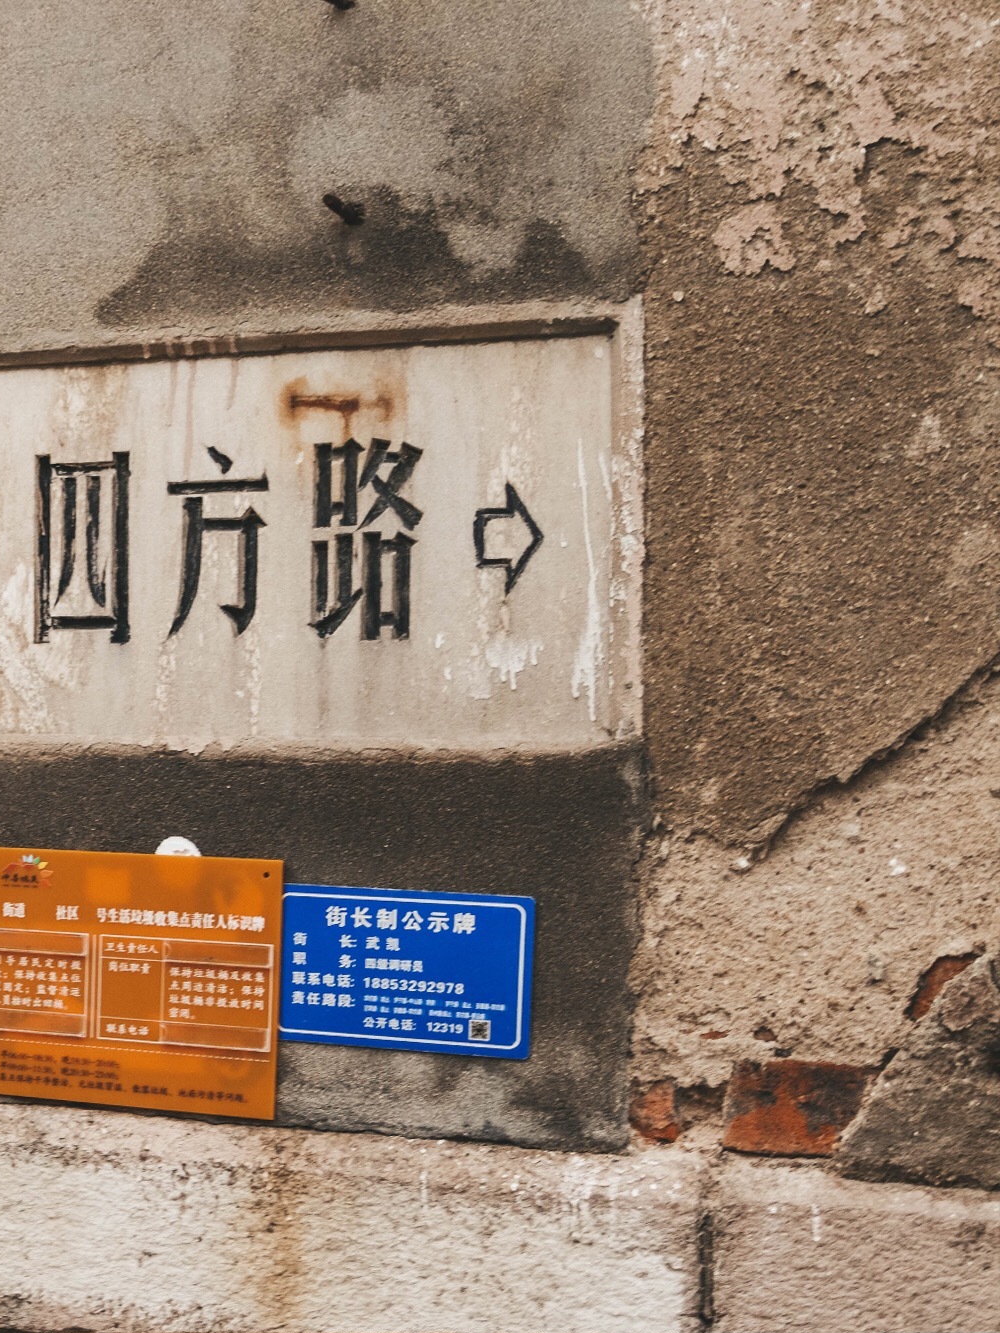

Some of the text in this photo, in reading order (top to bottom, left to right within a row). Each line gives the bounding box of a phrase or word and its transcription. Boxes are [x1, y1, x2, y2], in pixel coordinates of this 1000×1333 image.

[34, 438, 424, 644] 四方路
[2, 902, 26, 919] 街道
[55, 905, 79, 921] 社区
[325, 905, 477, 935] 街长制公示牌
[363, 976, 465, 995] 18853292978
[425, 1021, 464, 1034] 12319
